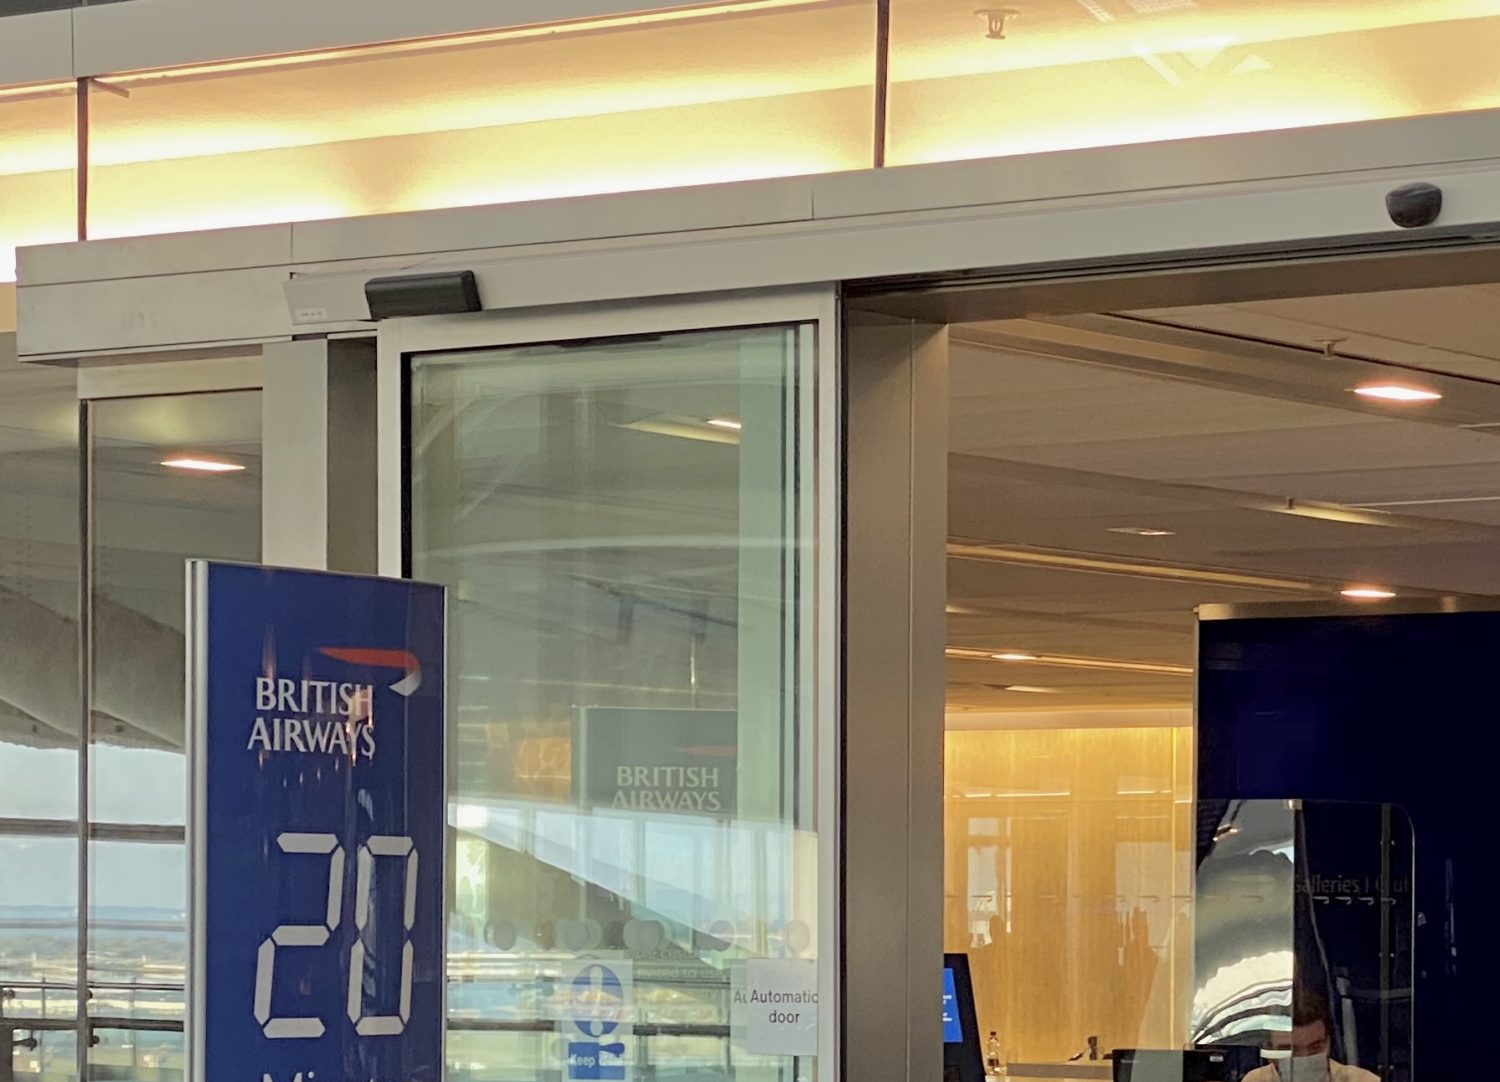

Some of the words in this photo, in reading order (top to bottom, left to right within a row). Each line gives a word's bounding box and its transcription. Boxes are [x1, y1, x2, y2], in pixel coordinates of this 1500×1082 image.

[255, 677, 373, 715] BRITISH
[247, 717, 376, 757] AIRWAYS
[616, 765, 719, 788] BRITISH
[611, 789, 721, 812] AIRWAYS
[253, 832, 419, 1039] 20
[750, 989, 819, 1005] Automatic
[768, 1009, 801, 1024] door
